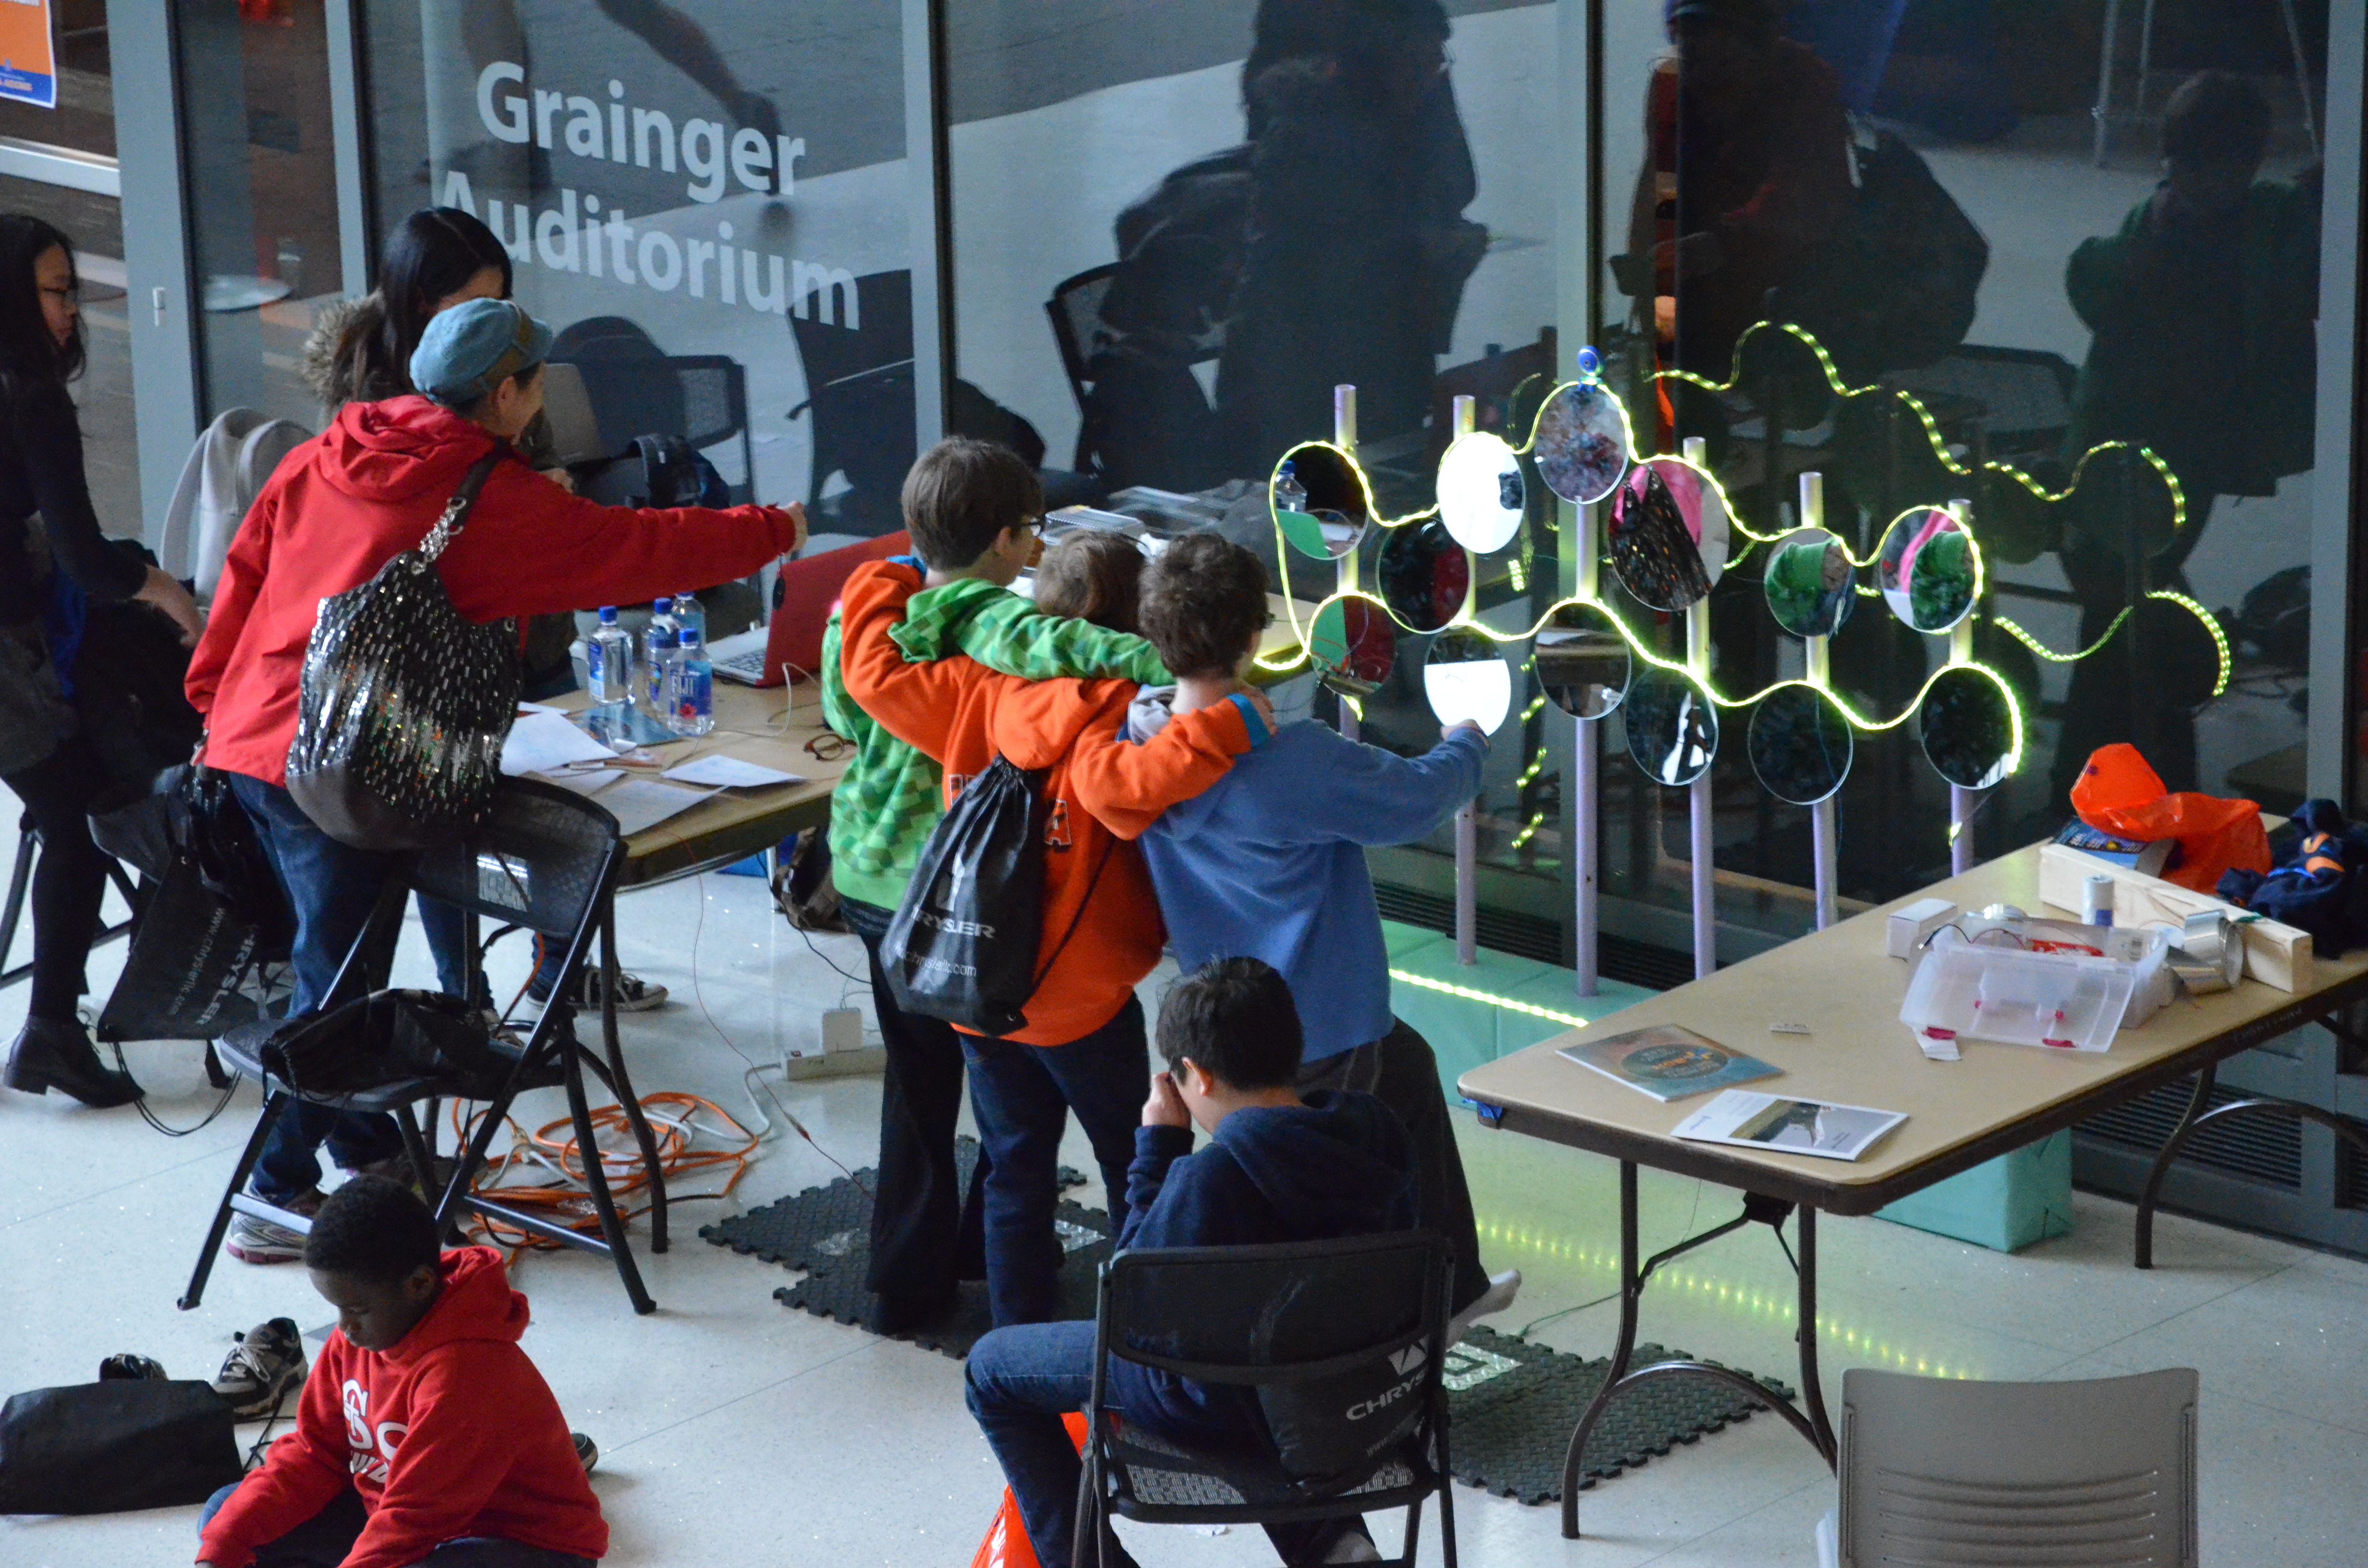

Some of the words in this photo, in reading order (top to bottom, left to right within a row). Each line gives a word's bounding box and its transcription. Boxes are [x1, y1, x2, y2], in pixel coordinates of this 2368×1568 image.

[477, 61, 805, 203] Grainger
[442, 170, 860, 331] Auditorium
[1346, 1364, 1429, 1421] CHRYS
